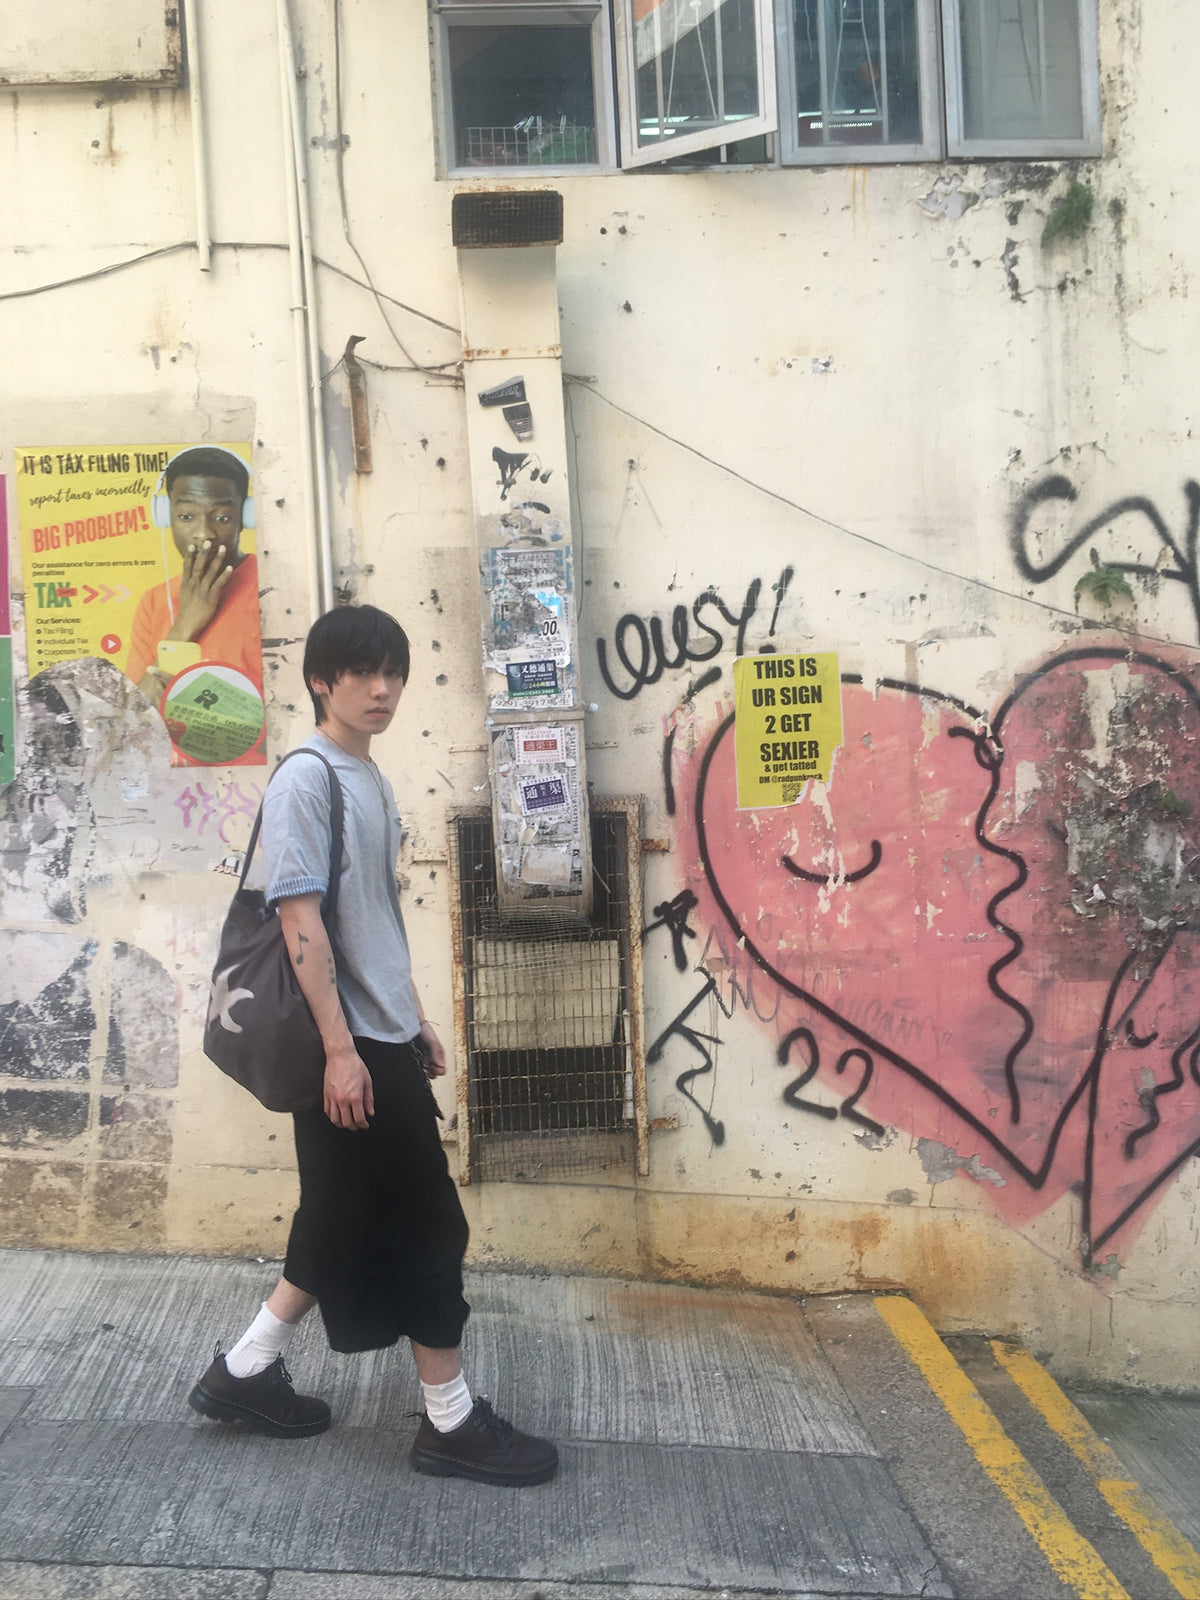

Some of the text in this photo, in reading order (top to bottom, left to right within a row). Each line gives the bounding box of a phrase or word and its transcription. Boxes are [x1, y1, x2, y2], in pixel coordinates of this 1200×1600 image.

[23, 451, 168, 475] IT IS TAX FILING TIME!
[29, 478, 151, 509] report taxes incorrectly
[33, 506, 150, 553] BIG PROBLEM!
[34, 581, 72, 608] TAX
[753, 657, 817, 679] THIS IS
[752, 685, 822, 707] UR SIGN
[765, 713, 812, 734] 2 GET
[760, 740, 819, 762] SEXIER
[764, 760, 817, 773] & get tatted
[759, 775, 770, 784] DM
[777, 1027, 885, 1138] 22
